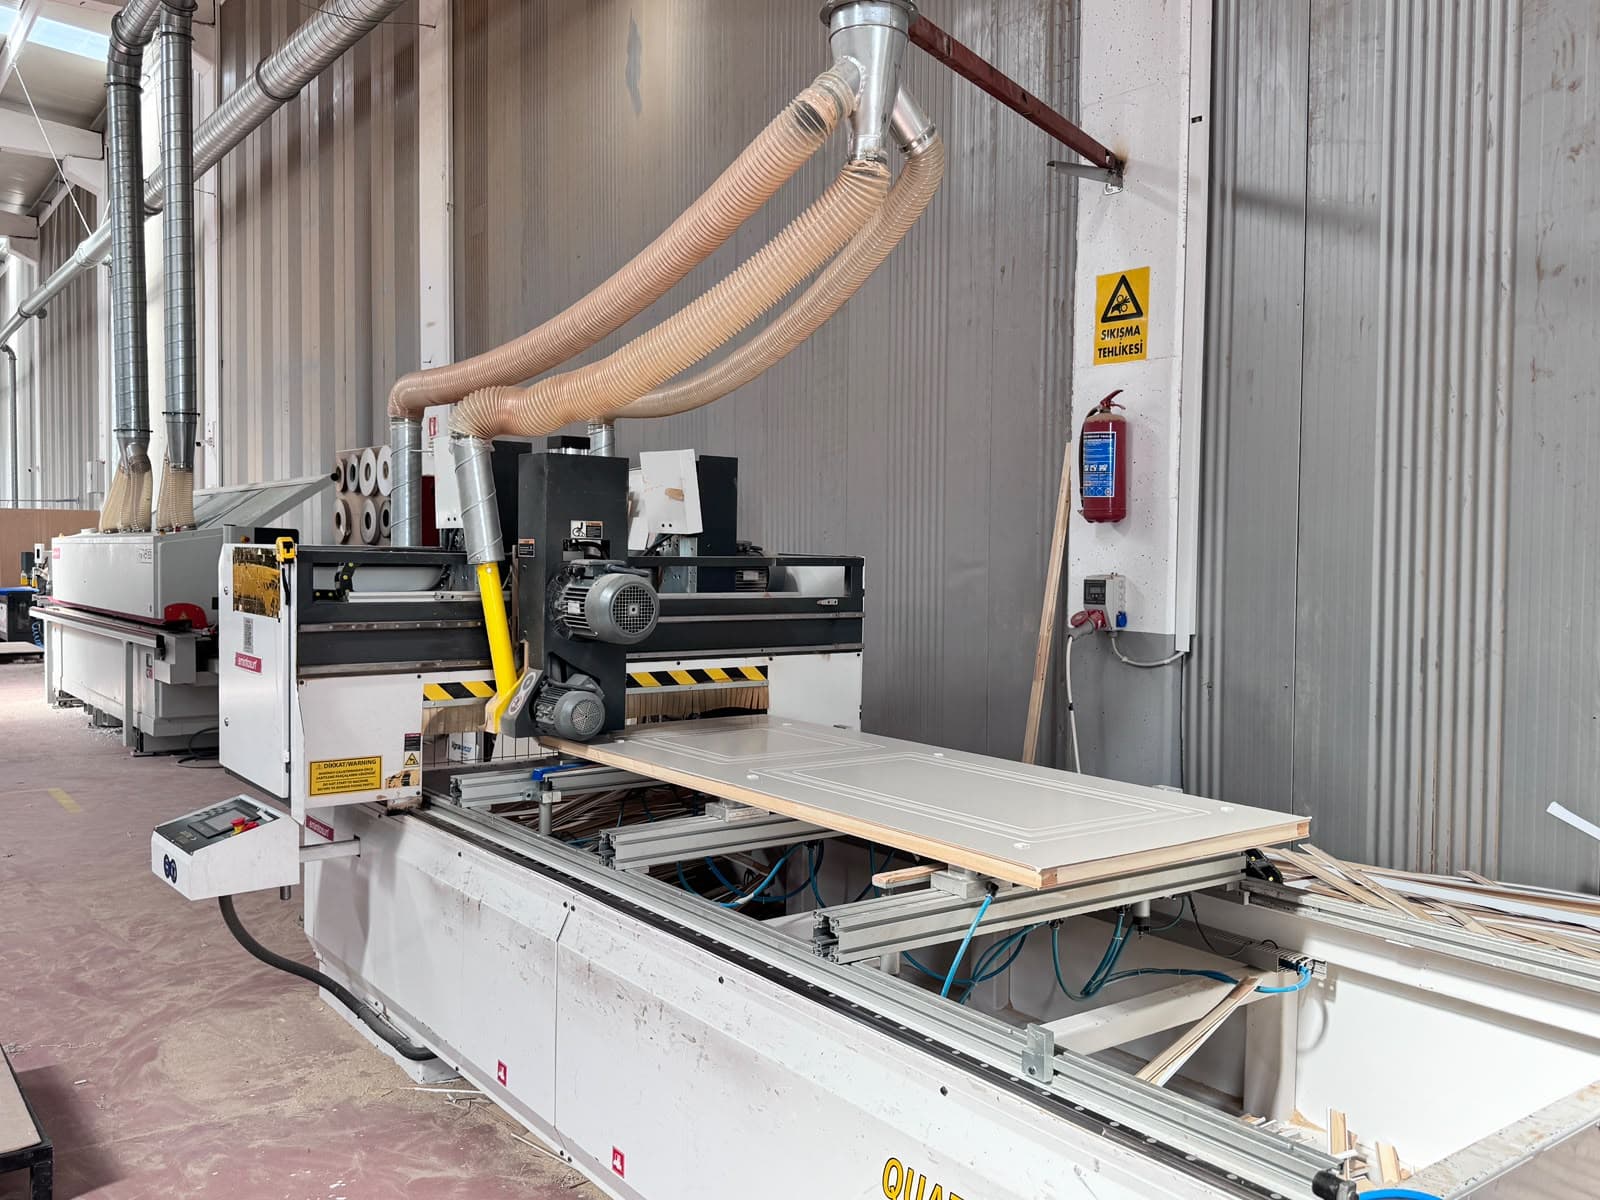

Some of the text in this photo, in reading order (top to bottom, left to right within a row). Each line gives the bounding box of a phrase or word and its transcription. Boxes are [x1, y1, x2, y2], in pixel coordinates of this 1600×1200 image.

[1101, 325, 1140, 340] SIKIŞMA
[1098, 339, 1143, 358] TEHLİKESİ
[324, 760, 376, 769] DİKKAT/WARNING
[882, 1157, 965, 1200] QU
